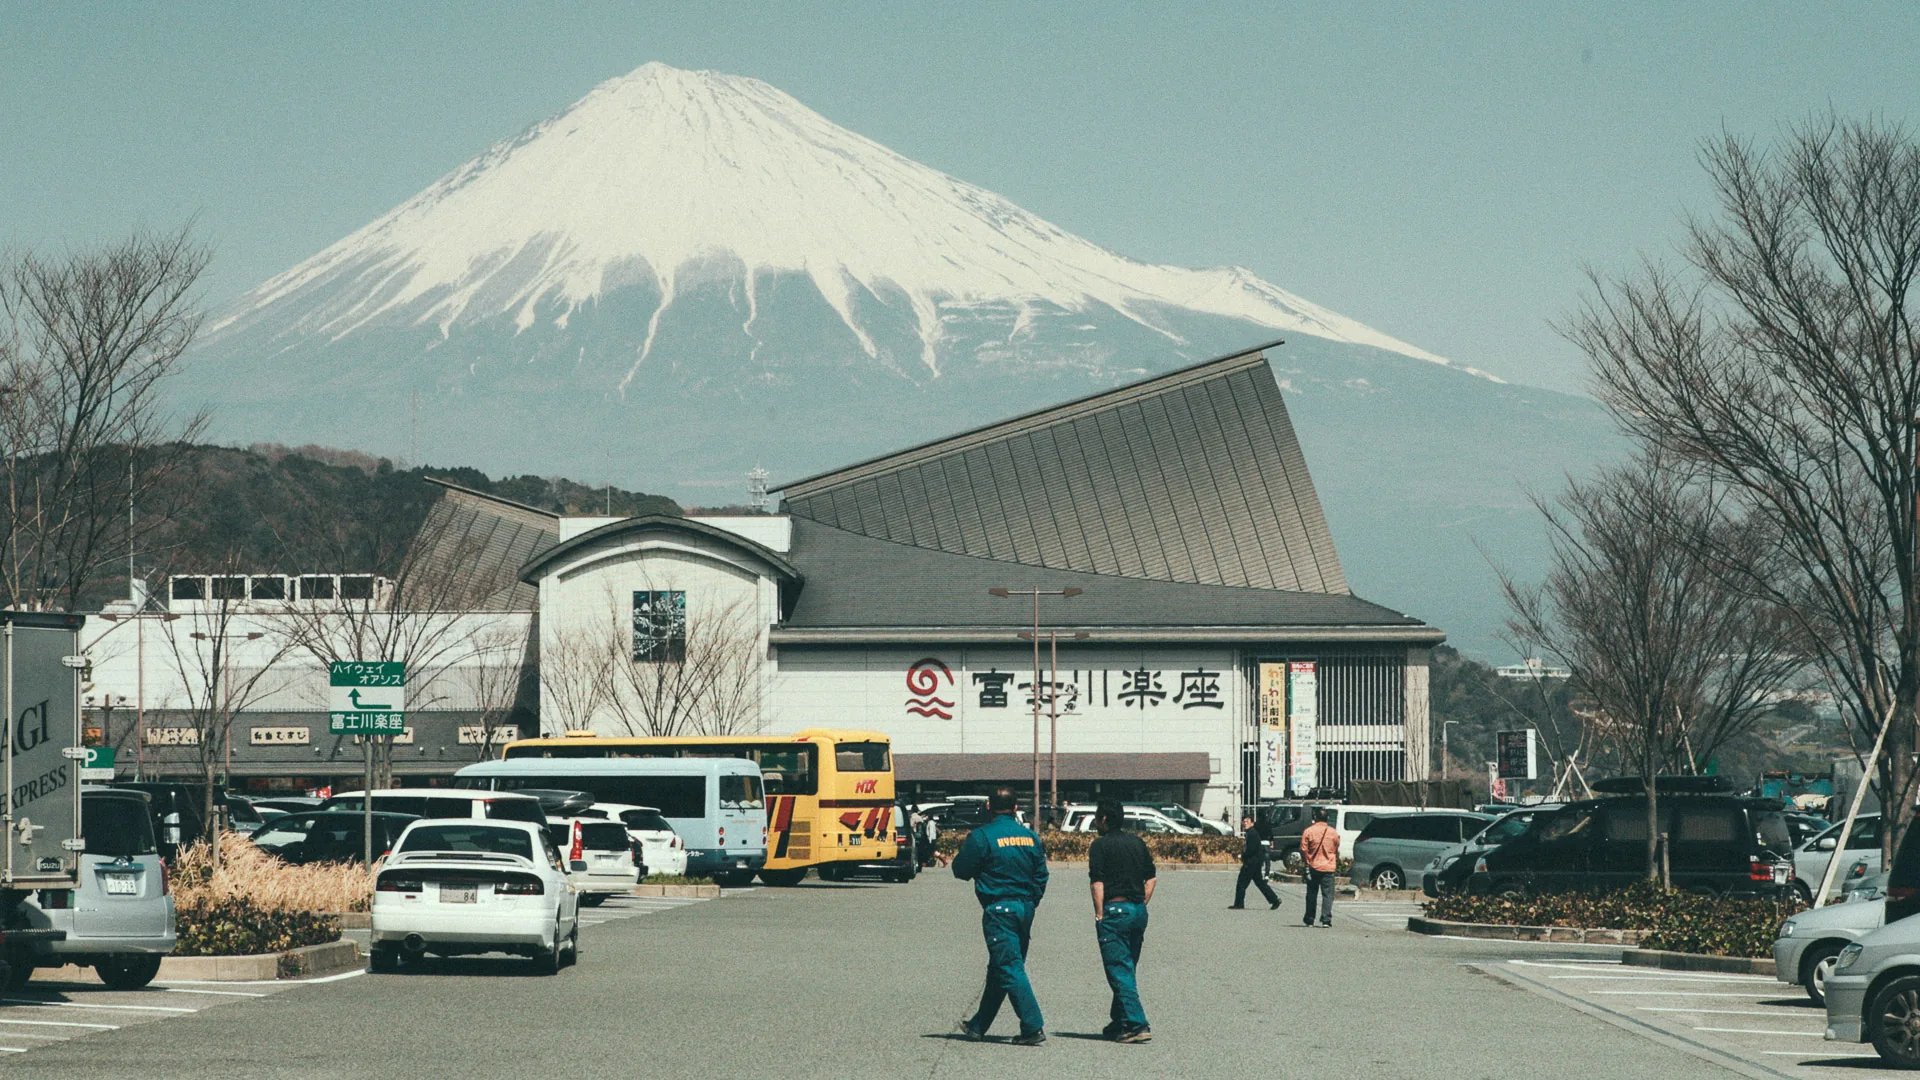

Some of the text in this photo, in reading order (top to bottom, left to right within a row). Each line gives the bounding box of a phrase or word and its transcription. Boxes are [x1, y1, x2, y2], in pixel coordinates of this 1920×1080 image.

[333, 664, 385, 674] ハイウェイ
[360, 675, 401, 685] オアシス
[972, 667, 1225, 711] 富士川楽座
[331, 713, 403, 729] 富士川楽座
[84, 748, 98, 768] P
[41, 861, 60, 870] ISUZU
